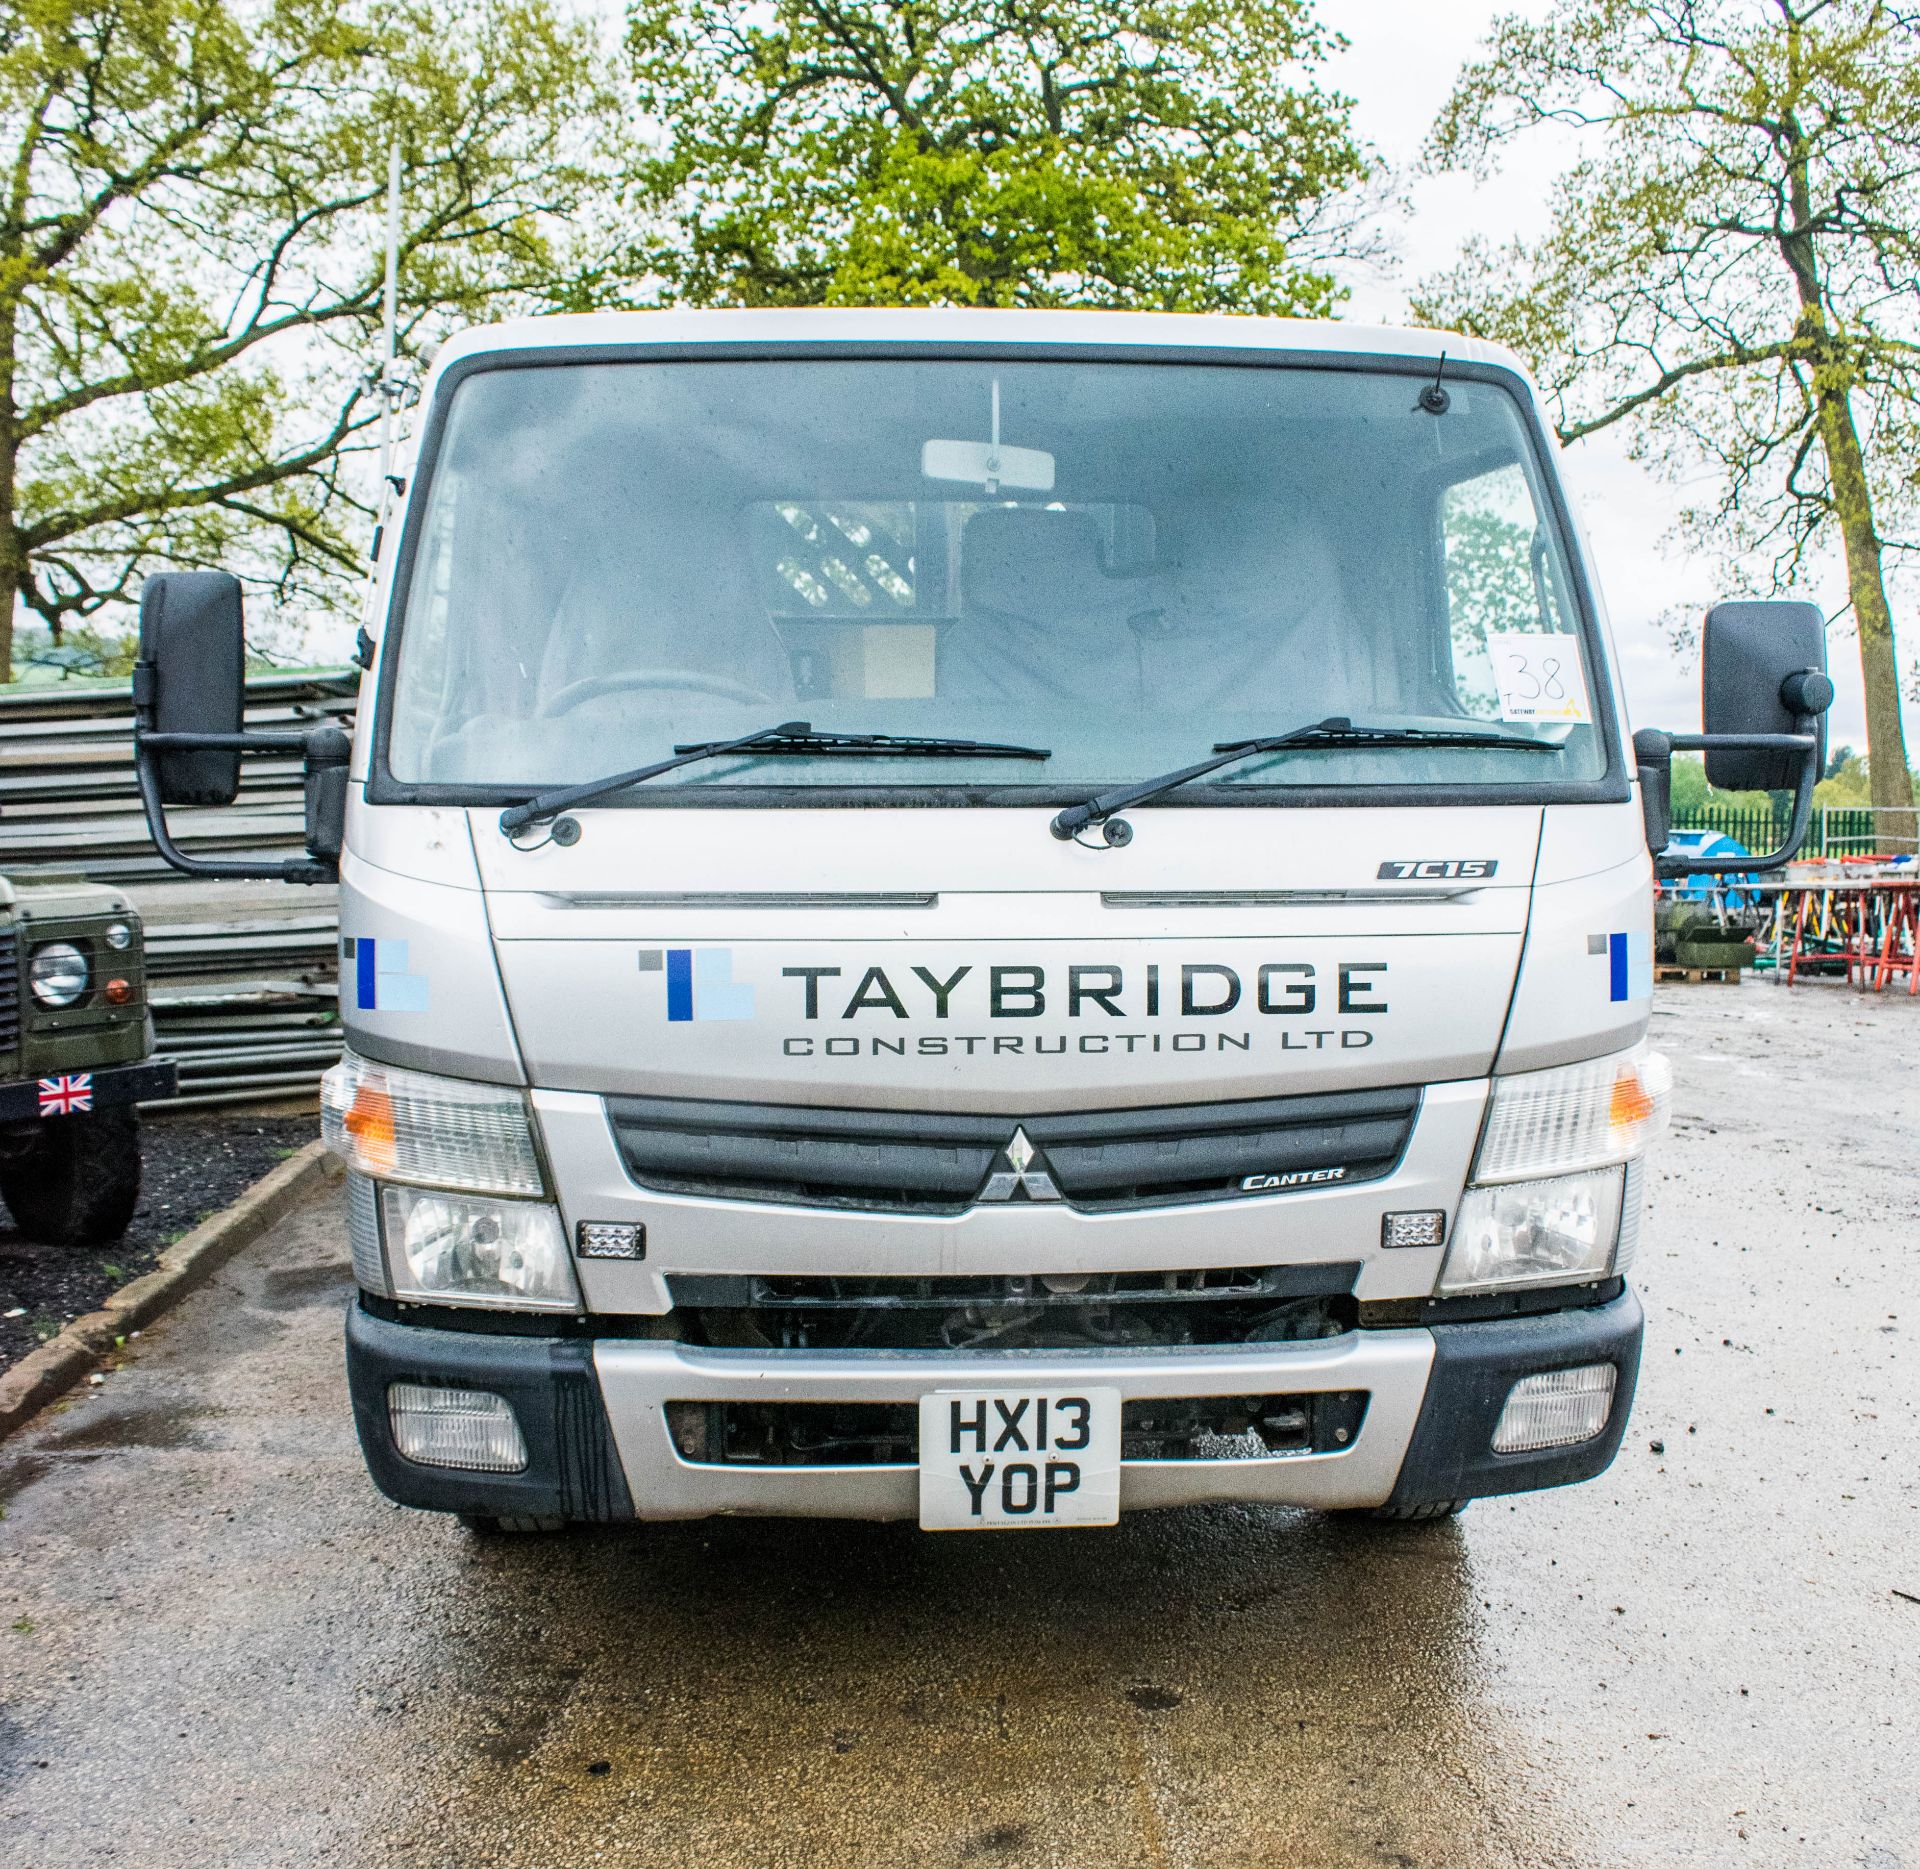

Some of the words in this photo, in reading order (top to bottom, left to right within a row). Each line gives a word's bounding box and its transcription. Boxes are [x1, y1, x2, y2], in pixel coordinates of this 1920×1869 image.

[1508, 654, 1565, 700] 38
[1393, 861, 1487, 878] 7C15
[782, 962, 1388, 1020] TAYBRIDGE
[783, 1032, 1250, 1056] CONSTRUCTION
[1281, 1030, 1374, 1050] LTD
[950, 1397, 1091, 1454] HX13
[959, 1462, 1081, 1516] YOP
